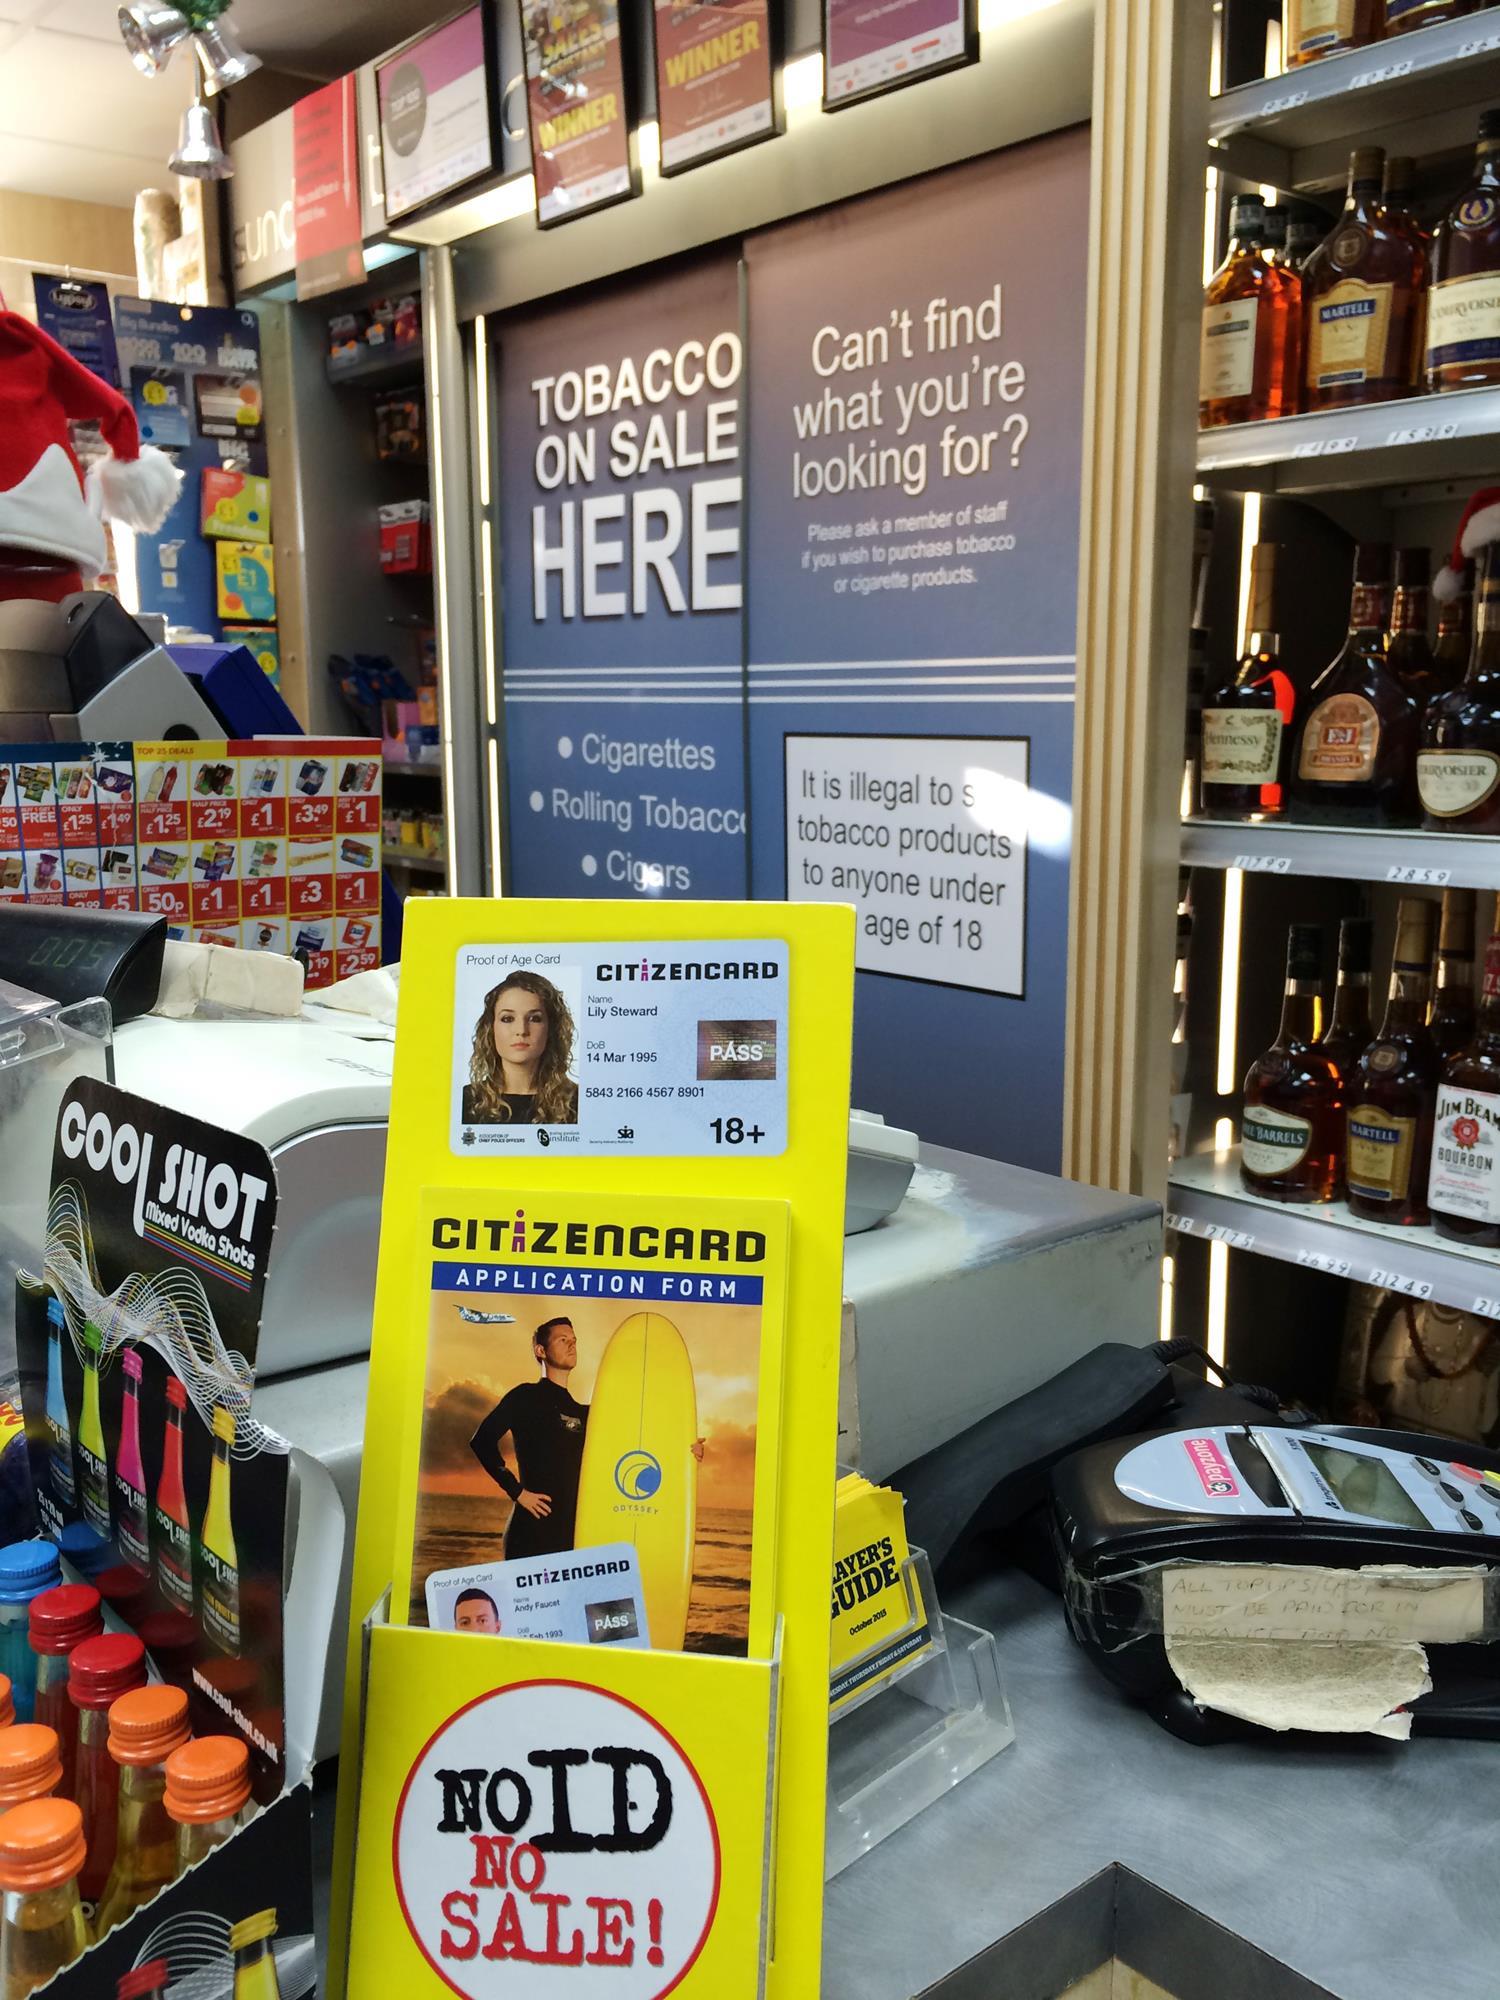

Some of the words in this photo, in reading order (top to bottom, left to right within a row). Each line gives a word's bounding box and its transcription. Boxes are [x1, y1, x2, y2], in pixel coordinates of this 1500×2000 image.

[665, 21, 760, 88] WINNER
[539, 93, 618, 150] WINNER
[1320, 301, 1370, 320] MARTELL
[811, 309, 914, 377] Can't
[924, 283, 1002, 352] find
[531, 331, 743, 427] TOBACCO
[792, 377, 883, 439] what
[895, 355, 1026, 436] you're
[535, 427, 596, 490] ON
[609, 399, 739, 478] SALE
[793, 439, 927, 498] looking
[807, 523, 852, 543] Please
[854, 517, 880, 537] ask
[882, 519, 893, 535] a
[894, 510, 953, 532] member
[956, 505, 972, 526] of
[974, 500, 1008, 524] staff
[532, 476, 743, 620] HERE
[812, 551, 837, 573] you
[839, 546, 870, 566] wish
[872, 545, 886, 564] to
[887, 539, 953, 565] purchase
[955, 533, 1017, 555] tobacco
[833, 578, 849, 594] or
[850, 570, 910, 596] cigarette
[136, 747, 154, 755] TOP
[169, 747, 194, 755] DEALS
[581, 732, 717, 774] Cigarettes
[802, 769, 820, 799] It
[823, 769, 842, 800] is
[850, 770, 920, 812] illegal
[929, 776, 953, 808] to
[22, 812, 57, 824] FREE
[63, 813, 94, 831] £1.25
[197, 807, 232, 828] £2.19
[250, 802, 273, 827] £1
[295, 803, 329, 824] £3.49
[345, 800, 367, 823] £1
[551, 787, 633, 834] Rolling
[146, 813, 181, 835] £1.25
[797, 813, 891, 849] tobacco
[898, 822, 1012, 863] products
[606, 849, 692, 892] Cigars
[803, 856, 825, 888] to
[831, 867, 921, 900] anyone
[929, 874, 1007, 907] under
[1391, 866, 1447, 883] 2859
[193, 882, 211, 890] ONLY
[250, 883, 272, 908] £1
[300, 880, 322, 904] £3
[344, 877, 366, 901] £1
[148, 891, 185, 914] 50p
[200, 886, 223, 912] £1
[864, 911, 911, 944] age
[918, 912, 944, 946] of
[951, 916, 984, 953] 18
[466, 954, 497, 966] Proof
[497, 953, 509, 965] of
[511, 953, 533, 967] Age
[534, 953, 561, 965] Card
[587, 994, 613, 1005] Name
[587, 1006, 608, 1018] Lily
[610, 1005, 658, 1018] Steward
[586, 1040, 606, 1050] DoB
[586, 1052, 601, 1064] 14
[603, 1052, 627, 1064] Mar
[629, 1051, 658, 1064] 1995
[585, 1087, 614, 1099] 5843
[616, 1087, 643, 1098] 2166
[646, 1087, 676, 1098] 4567
[677, 1086, 705, 1098] 8901
[1437, 1098, 1462, 1121] JIM
[709, 1116, 766, 1146] 18+
[1256, 1125, 1304, 1145] BARRELS
[1351, 1123, 1396, 1141] MARTELL
[60, 1100, 154, 1238] COOL
[158, 1143, 268, 1242] SHOT
[1438, 1146, 1494, 1171] BOURBON
[145, 1199, 181, 1233] mixed
[181, 1216, 217, 1252] Vodka
[217, 1235, 256, 1271] Shots
[1207, 1225, 1252, 1248] 2175
[1302, 1252, 1349, 1274] 2699
[455, 1267, 645, 1295] APPLICATION
[661, 1277, 737, 1299] FORM
[1371, 1270, 1430, 1297] 2249
[1190, 1438, 1233, 1484] payzone
[612, 1504, 660, 1515] ODYSSEY
[833, 1536, 893, 1585] AYER'S
[433, 1578, 451, 1590] Proof
[452, 1578, 460, 1587] of
[460, 1576, 474, 1586] Age
[475, 1573, 493, 1584] Card
[1171, 1578, 1213, 1594] ALL
[514, 1603, 533, 1614] Andy
[534, 1599, 561, 1610] Faucet
[1172, 1604, 1231, 1617] MUST
[1243, 1601, 1270, 1617] BE
[1341, 1600, 1384, 1614] FOR
[1396, 1601, 1419, 1613] IN
[545, 1629, 563, 1640] 1993
[849, 1618, 874, 1637] October
[873, 1608, 887, 1624] 2015
[434, 1767, 532, 1834] NO
[527, 1746, 673, 1853] ID
[469, 1834, 547, 1892] NO
[439, 1890, 664, 1967] SALE!
